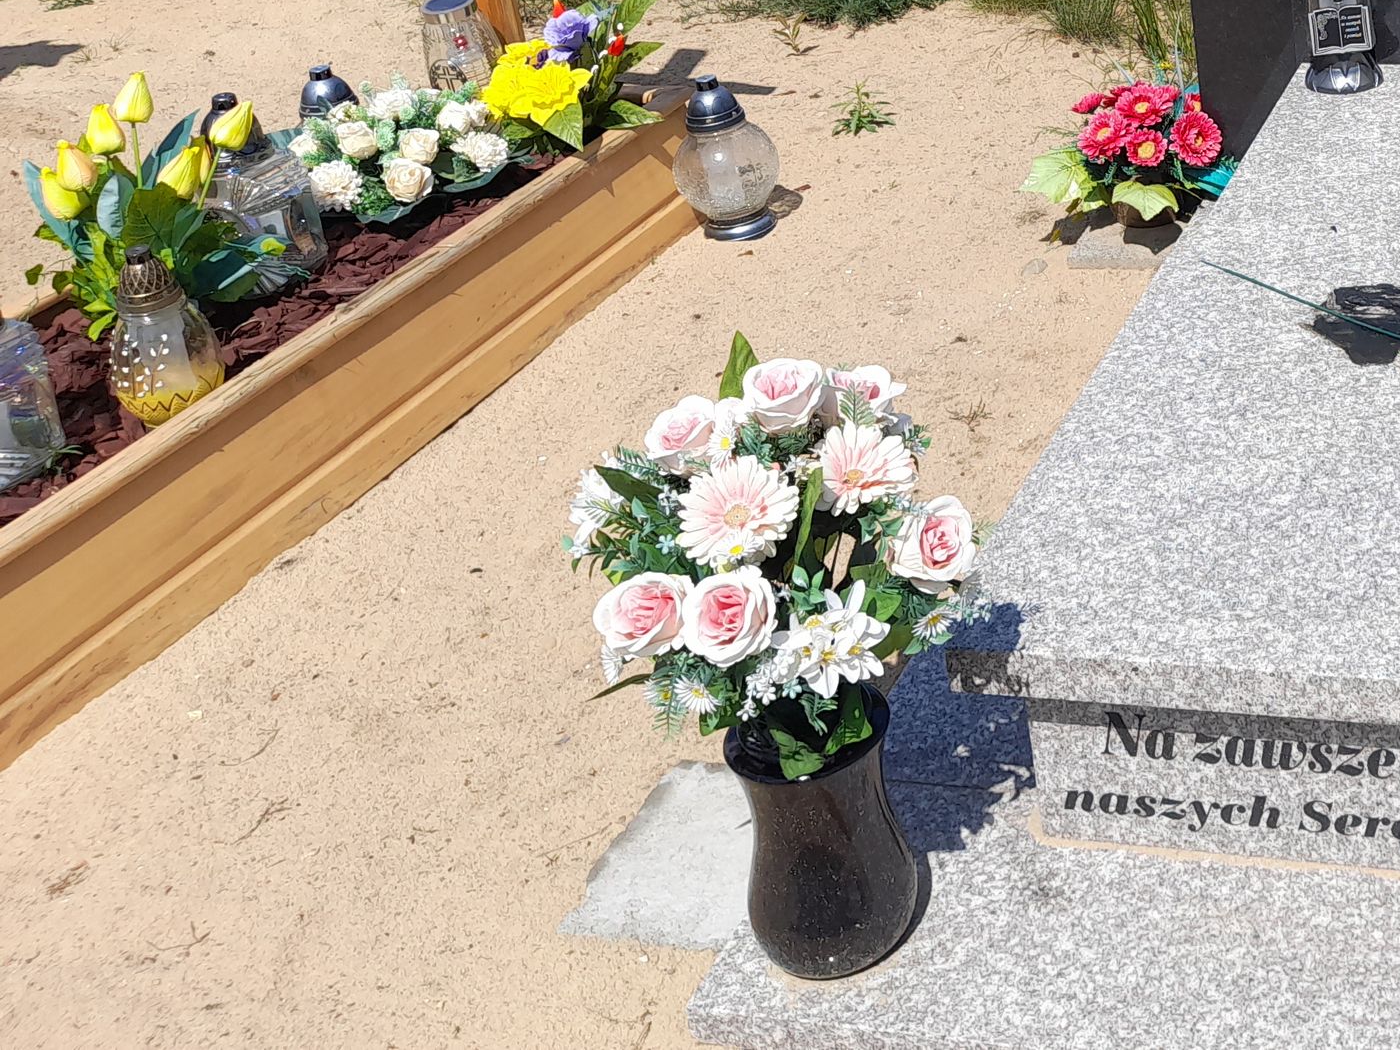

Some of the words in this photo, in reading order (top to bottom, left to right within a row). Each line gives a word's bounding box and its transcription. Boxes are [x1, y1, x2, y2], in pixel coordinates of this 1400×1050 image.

[1100, 711, 1178, 761] Na
[1193, 732, 1397, 780] zawsze
[1063, 788, 1280, 832] naszych
